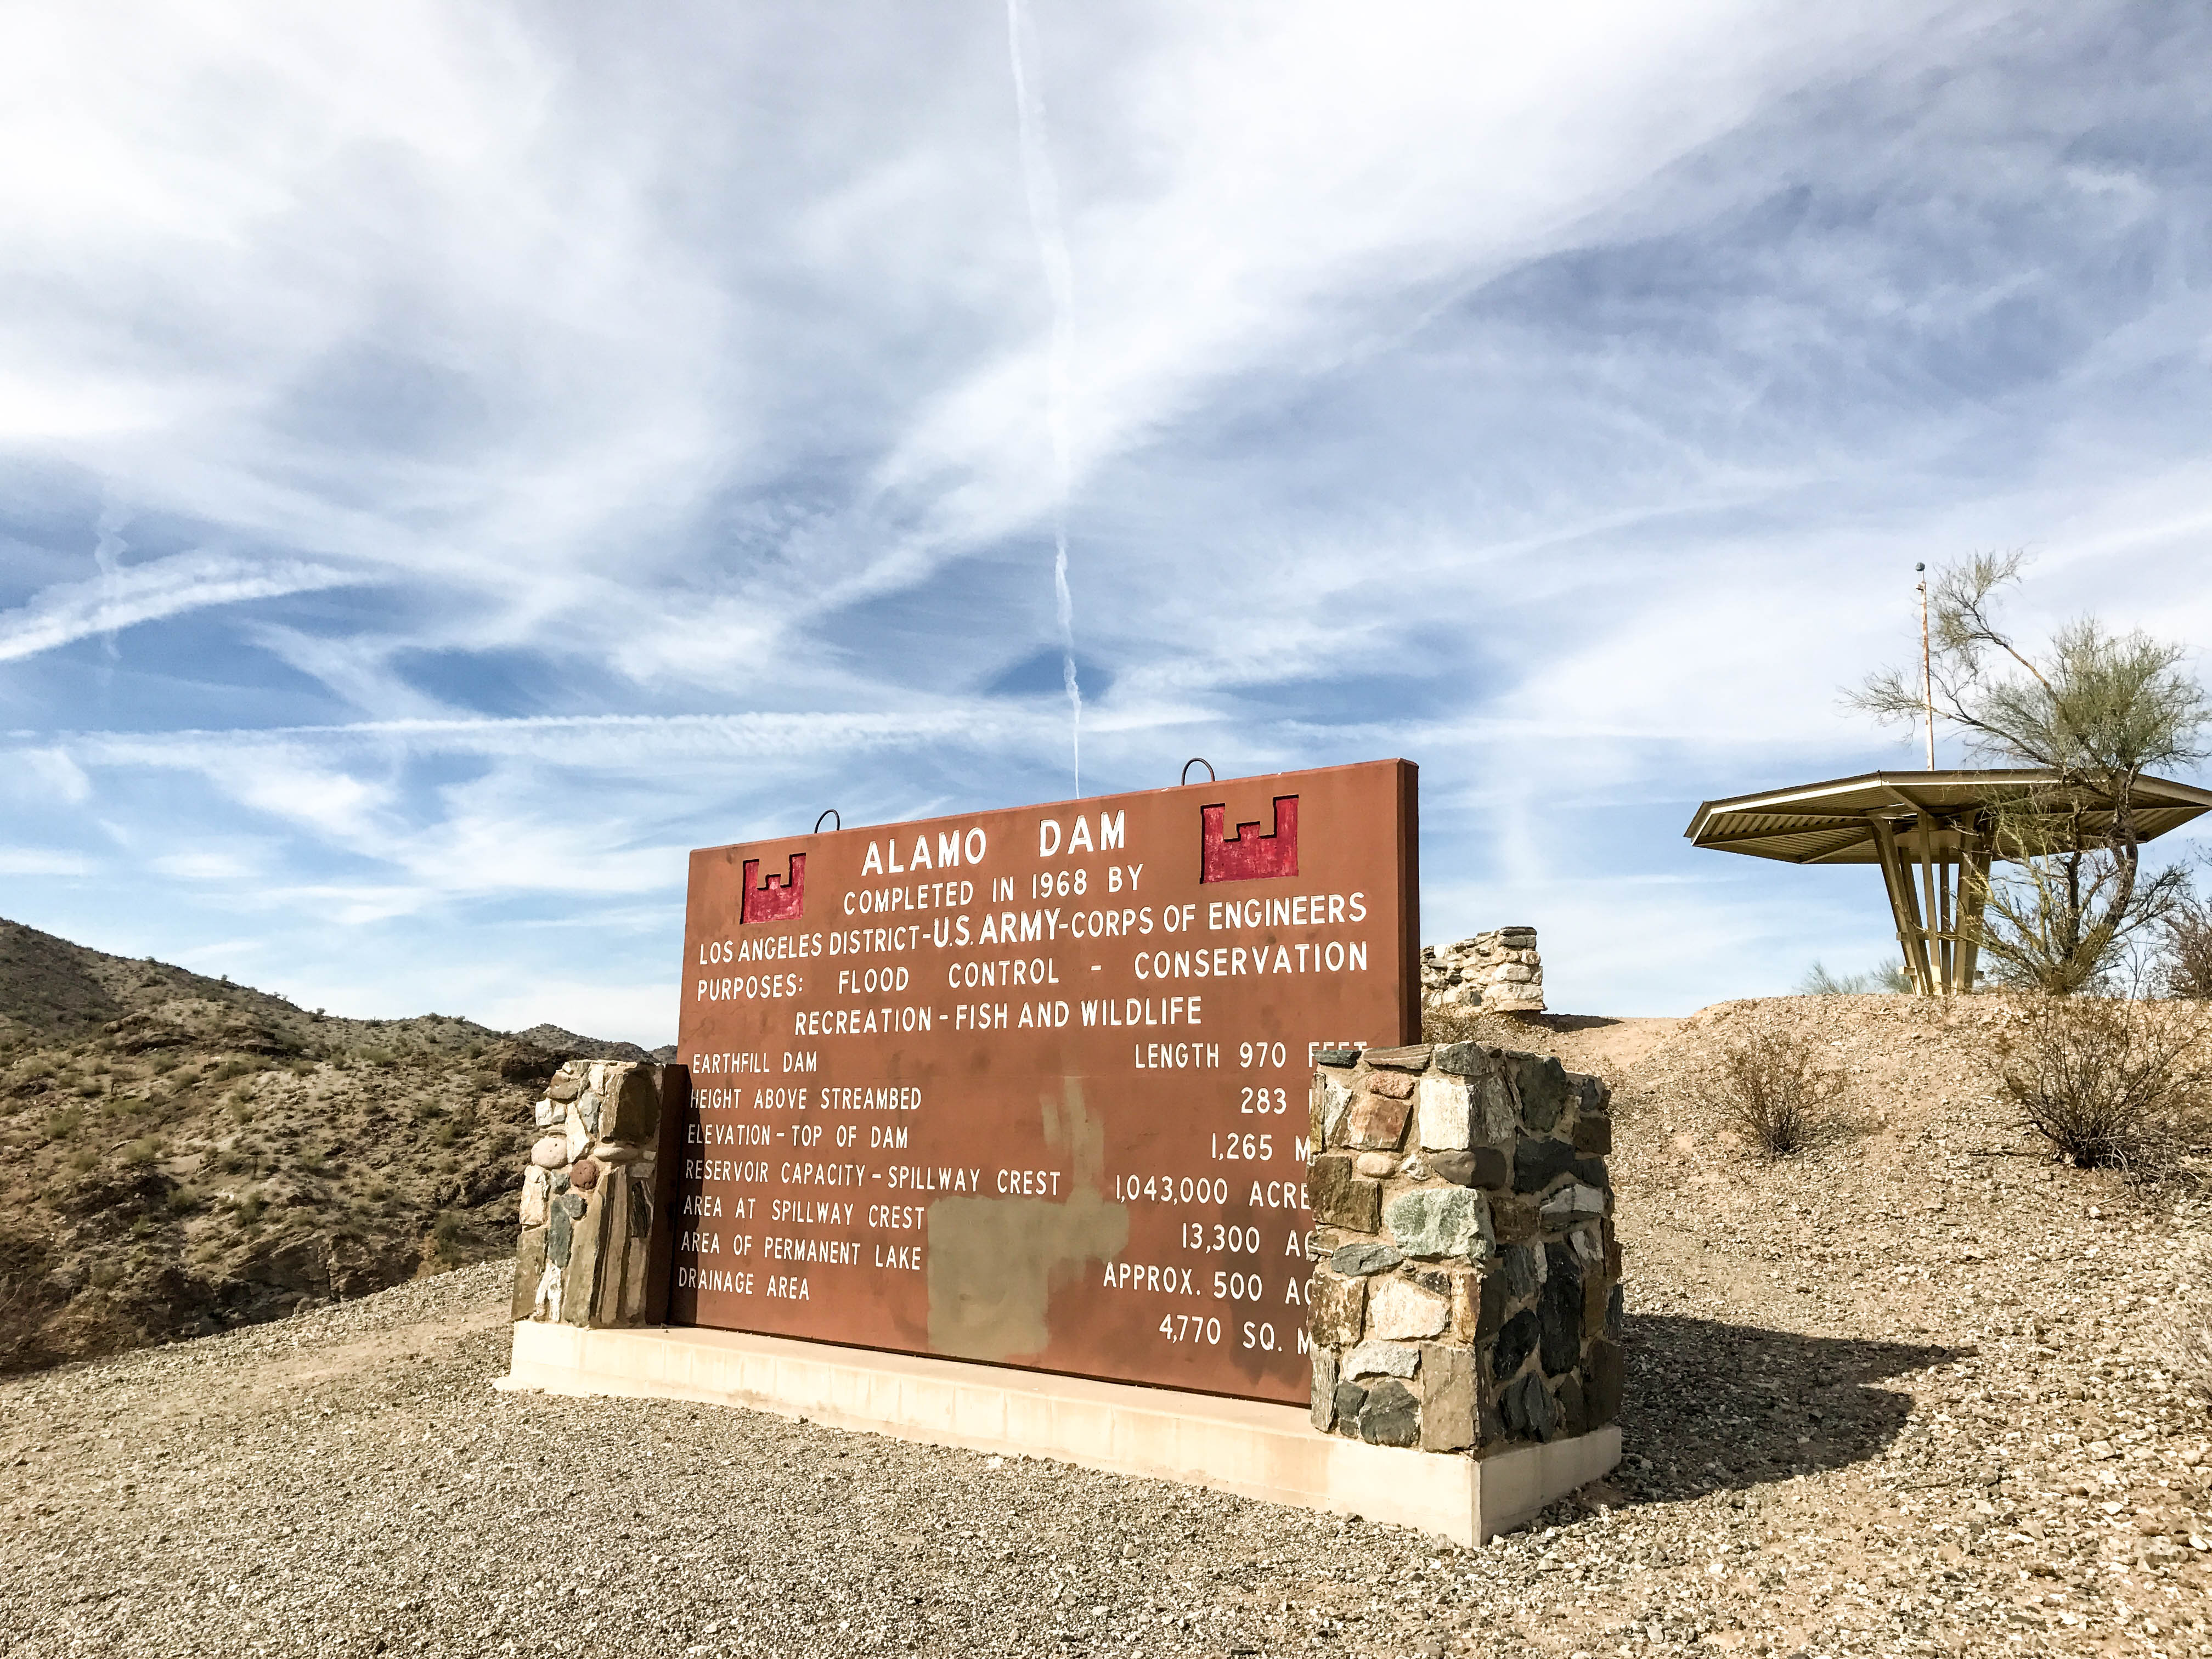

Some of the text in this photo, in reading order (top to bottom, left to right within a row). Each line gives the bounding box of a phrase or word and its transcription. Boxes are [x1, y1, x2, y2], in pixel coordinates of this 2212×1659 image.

[861, 810, 1124, 876] ALAMO DAM
[844, 864, 1143, 915] COMPLETED IN 1968 BY
[700, 940, 733, 964] LOS
[738, 933, 822, 962] ANGELES
[1164, 904, 1195, 932] OF
[1209, 892, 1367, 930] ENGINEERS
[698, 973, 803, 1001] PURPOSES:
[839, 967, 909, 994] FLOOD
[949, 958, 1059, 988] CONTROL
[1135, 941, 1367, 979] CONSERVATION
[795, 1006, 931, 1035] RECREATION
[956, 1003, 1007, 1030] FISH
[1018, 1001, 1069, 1028] AND
[1081, 996, 1201, 1026] WILDLIFE
[693, 1051, 816, 1074] EARTHFILL DAM
[1136, 1043, 1218, 1068] LENGTH
[1240, 1042, 1286, 1068] 970
[691, 1087, 921, 1110] HEIGHT ABOVE STREAMBED
[1242, 1087, 1286, 1114] 283
[688, 1124, 770, 1145] ELEVATION
[792, 1125, 822, 1147] TOP
[837, 1125, 856, 1147] OF
[871, 1126, 907, 1149] DAM
[1212, 1132, 1272, 1160] 1,265
[686, 1159, 768, 1182] RESERVOIR
[781, 1162, 865, 1187] CAPACITY
[888, 1166, 980, 1192] SPILLWAY
[997, 1169, 1060, 1195] CREST
[1117, 1175, 1227, 1205] 1,043,000
[684, 1195, 924, 1229] AREA AT SPILLWAY CREST
[681, 1231, 921, 1270] AREA OF PERMANENT LAKE
[1183, 1223, 1260, 1254] 13,300
[679, 1267, 809, 1300] DRAINAGE AREA
[1103, 1261, 1200, 1295] APPROX.
[1214, 1271, 1262, 1301] 500
[1159, 1314, 1221, 1345] 4,770
[1243, 1321, 1282, 1352] SQ.
